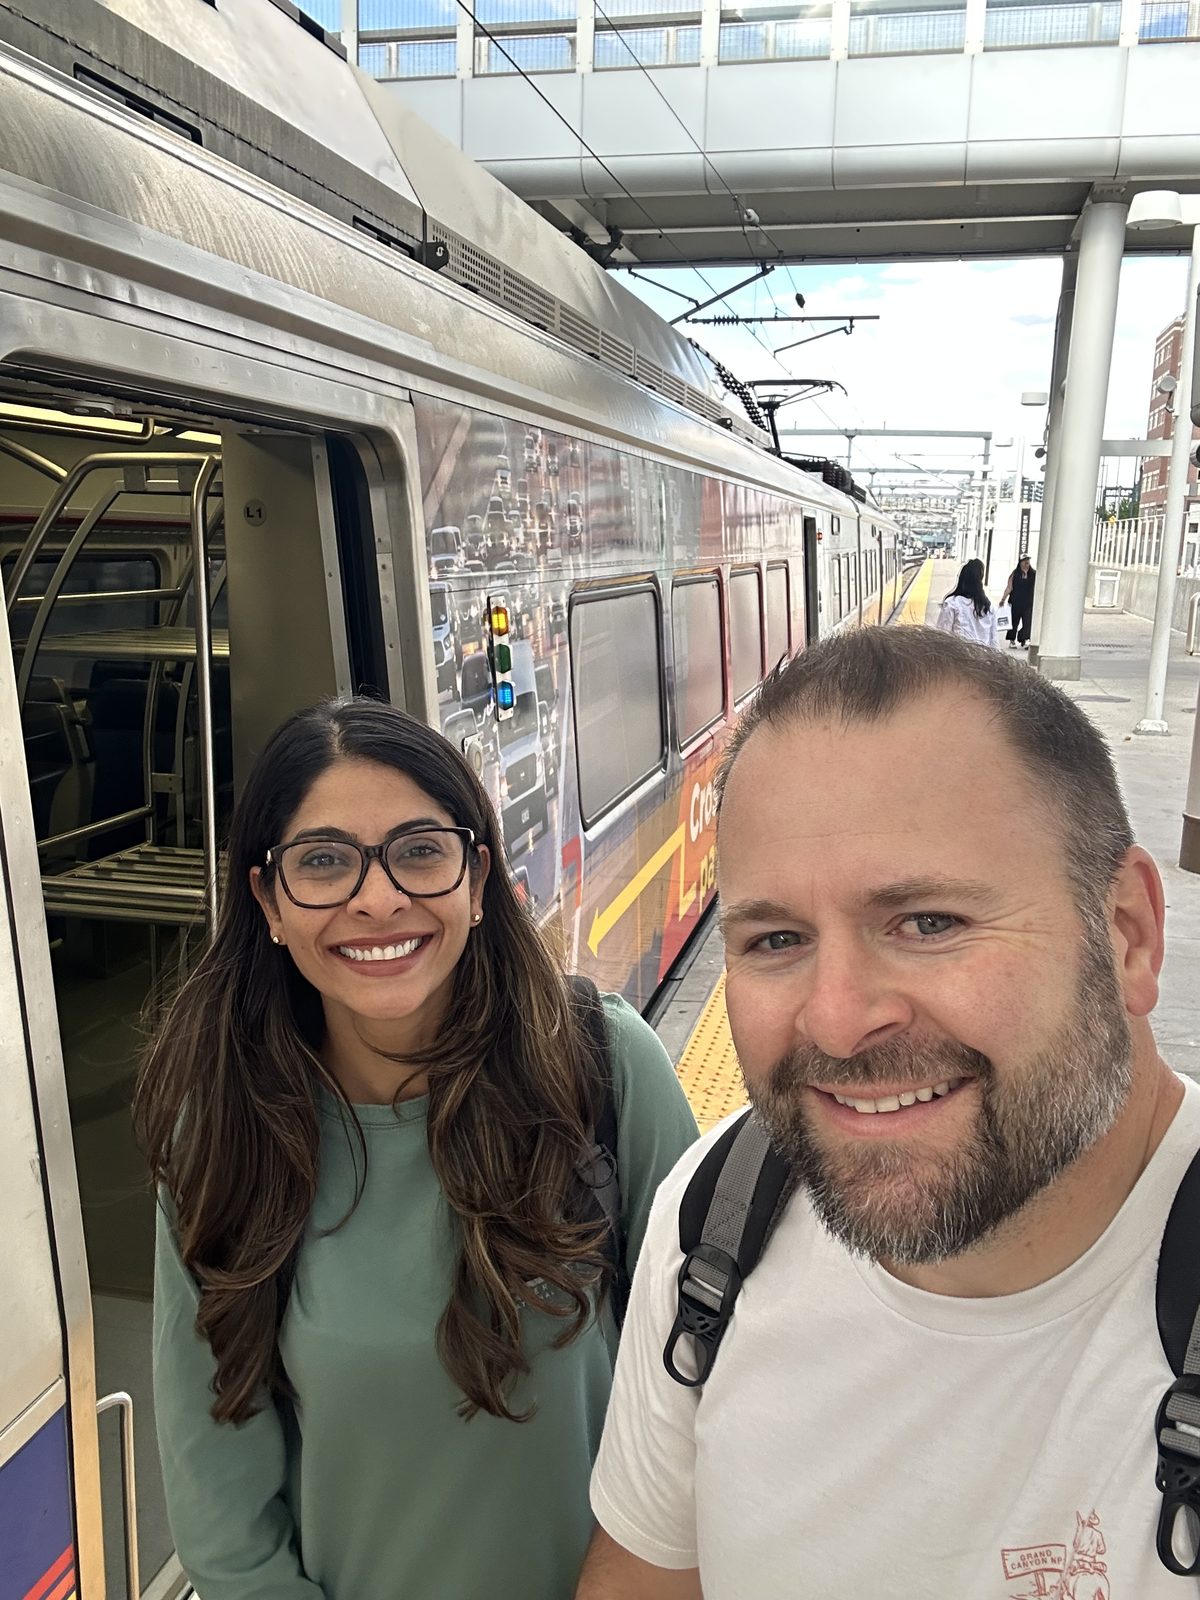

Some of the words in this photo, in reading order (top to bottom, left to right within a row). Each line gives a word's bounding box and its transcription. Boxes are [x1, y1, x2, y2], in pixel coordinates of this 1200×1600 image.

[246, 506, 262, 519] L1
[1020, 1549, 1052, 1561] GRAND
[1010, 1557, 1048, 1570] CANYON
[1051, 1556, 1063, 1565] NP
